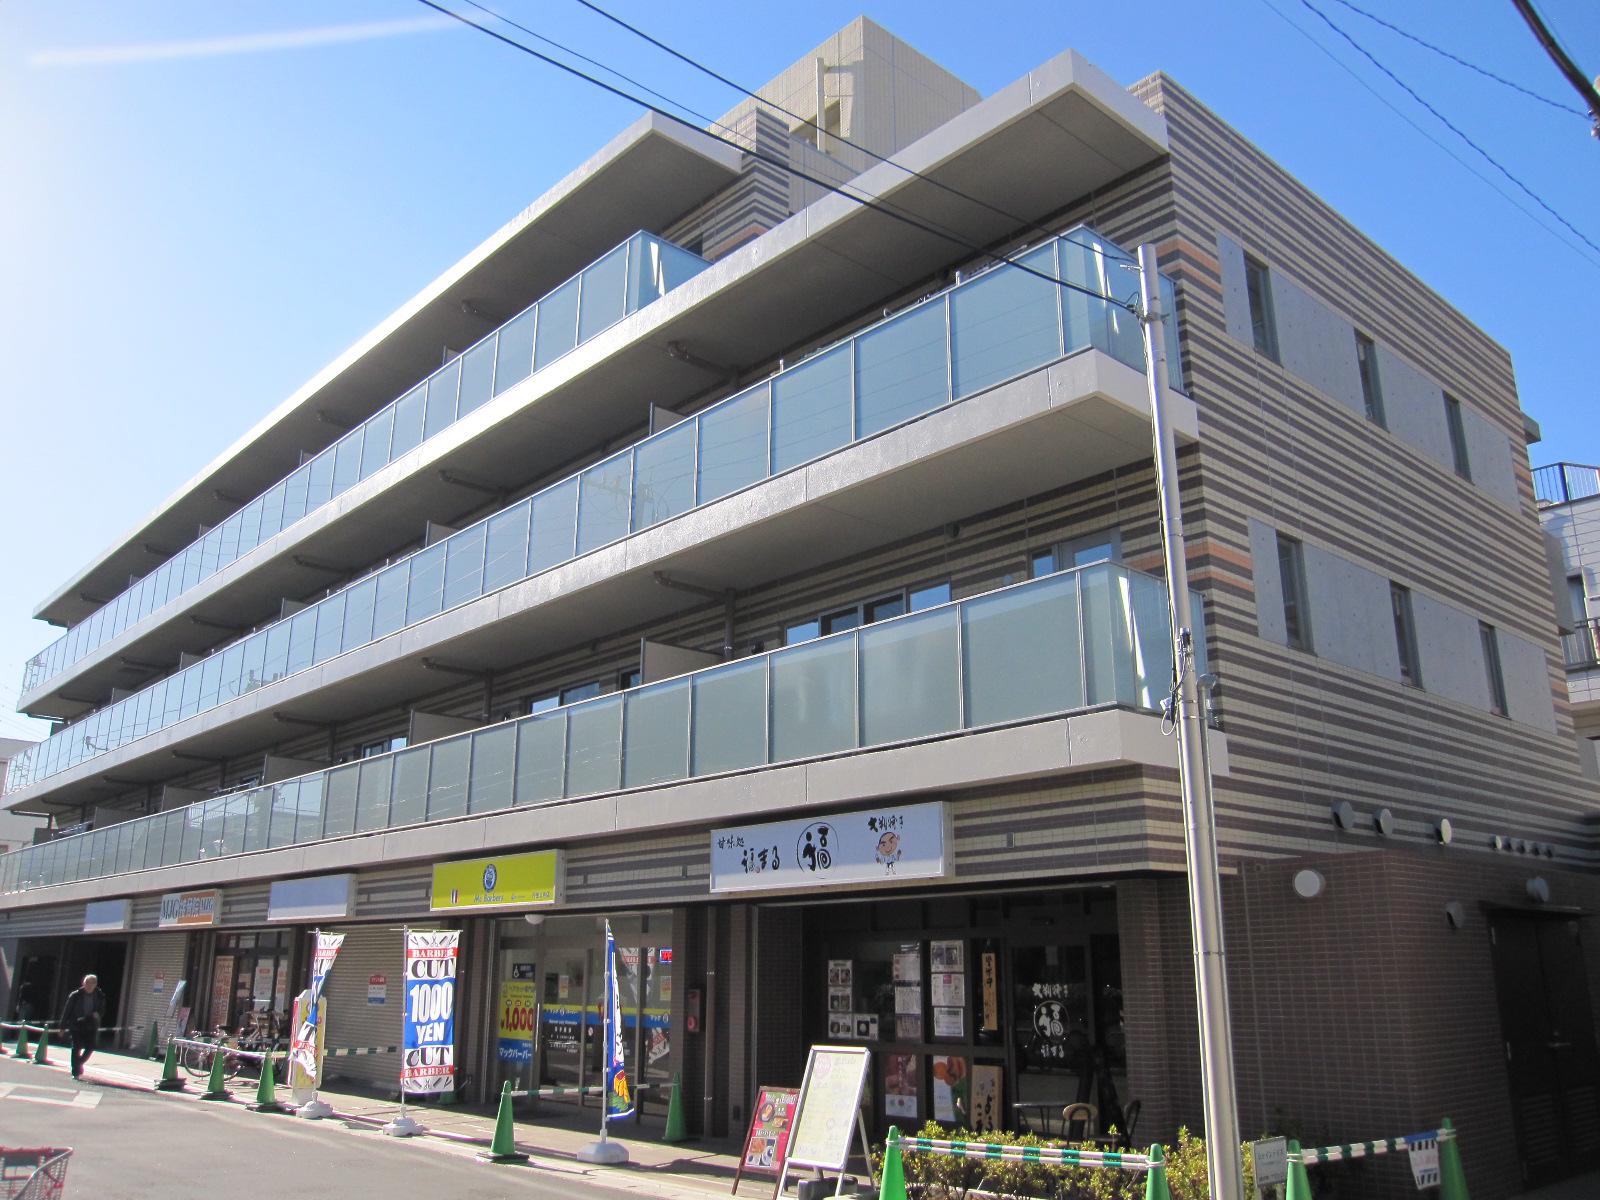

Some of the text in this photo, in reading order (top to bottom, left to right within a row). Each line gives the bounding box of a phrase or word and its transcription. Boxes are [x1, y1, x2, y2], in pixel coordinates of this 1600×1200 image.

[412, 948, 454, 958] BARBER
[411, 958, 455, 979] CUT
[409, 981, 453, 1023] 1000
[416, 1022, 445, 1044] YEN
[406, 1047, 450, 1066] CUT
[404, 1067, 451, 1078] BARBER
